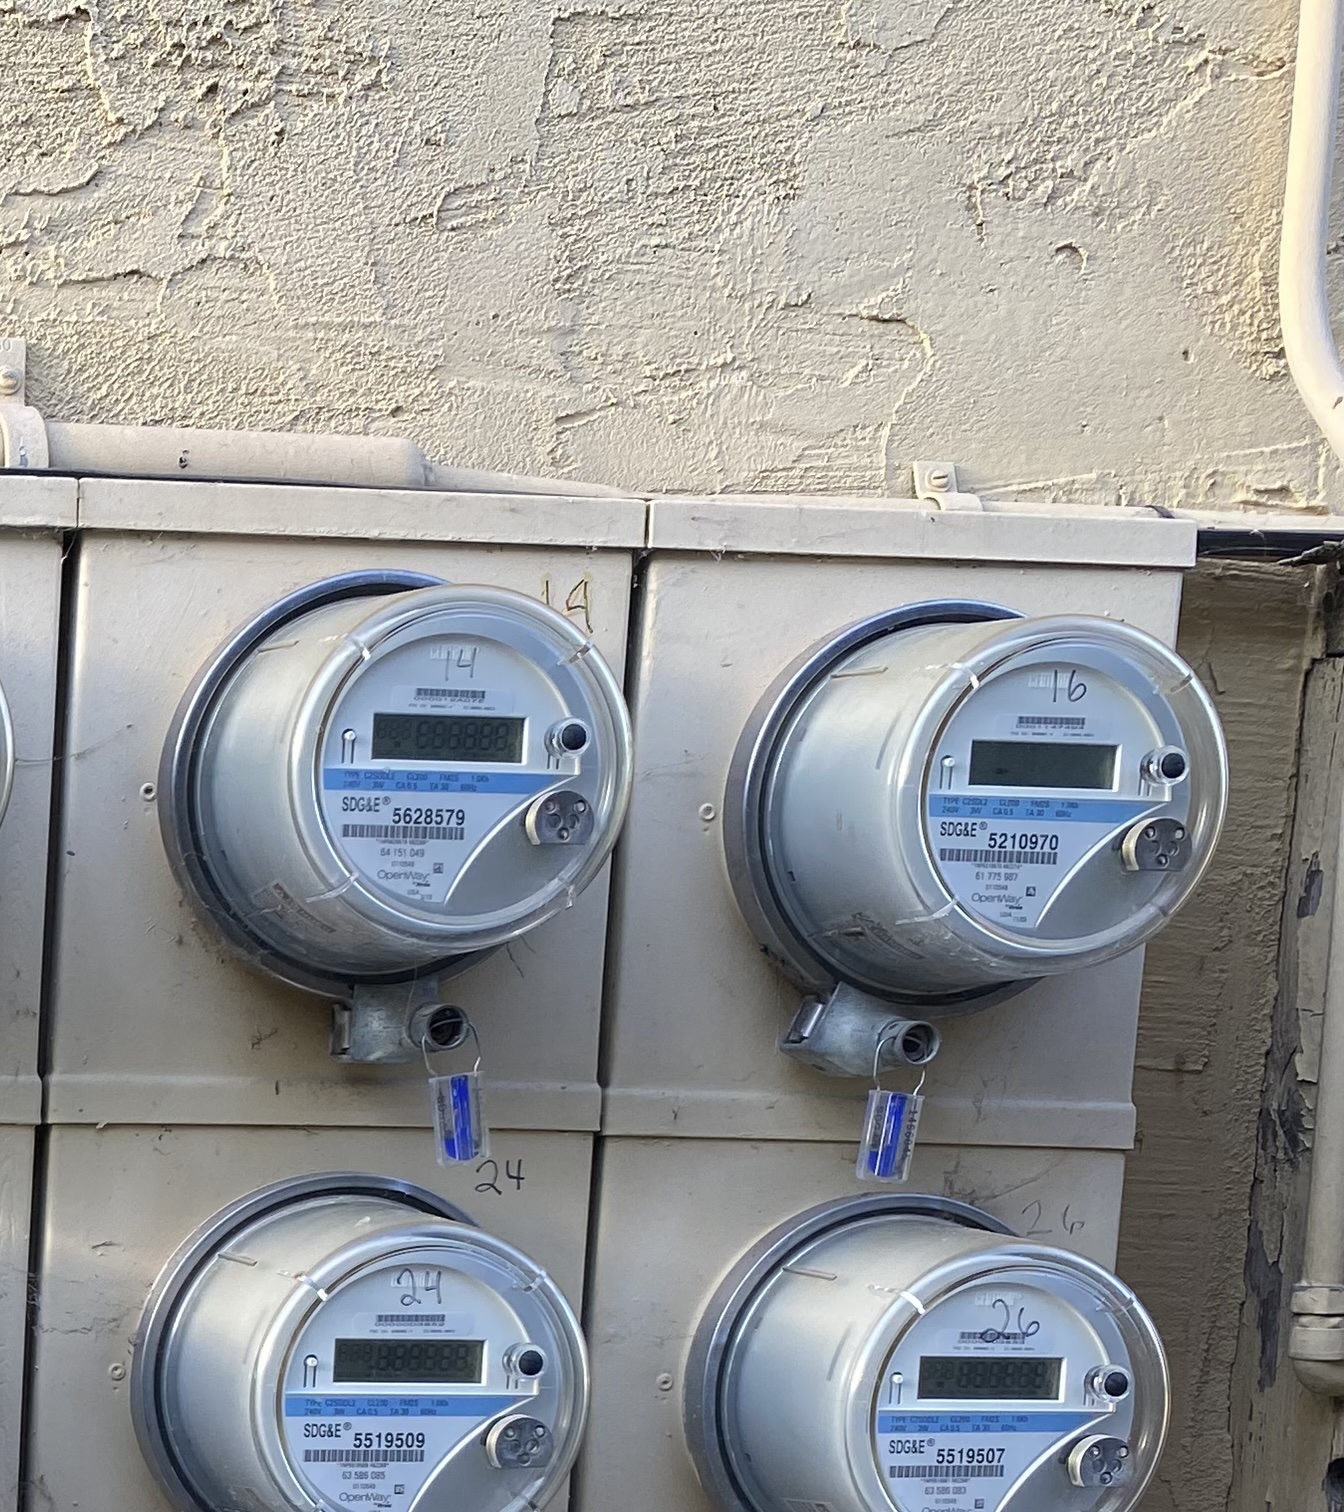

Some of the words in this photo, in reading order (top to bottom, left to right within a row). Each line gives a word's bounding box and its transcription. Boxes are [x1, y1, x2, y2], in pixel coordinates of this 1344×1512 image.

[444, 646, 478, 682] 14
[1052, 669, 1088, 703] 16
[392, 808, 466, 826] 5628579
[987, 833, 1059, 851] 5210970
[376, 870, 430, 884] OpenWay
[971, 893, 1023, 905] OpenWay
[474, 1159, 525, 1196] 24
[1021, 1199, 1086, 1237] 26
[396, 1267, 443, 1306] 24
[979, 1298, 1041, 1343] 26
[352, 1432, 426, 1449] 5519509
[936, 1448, 1006, 1464] 5519507
[339, 1492, 391, 1505] OpenWay
